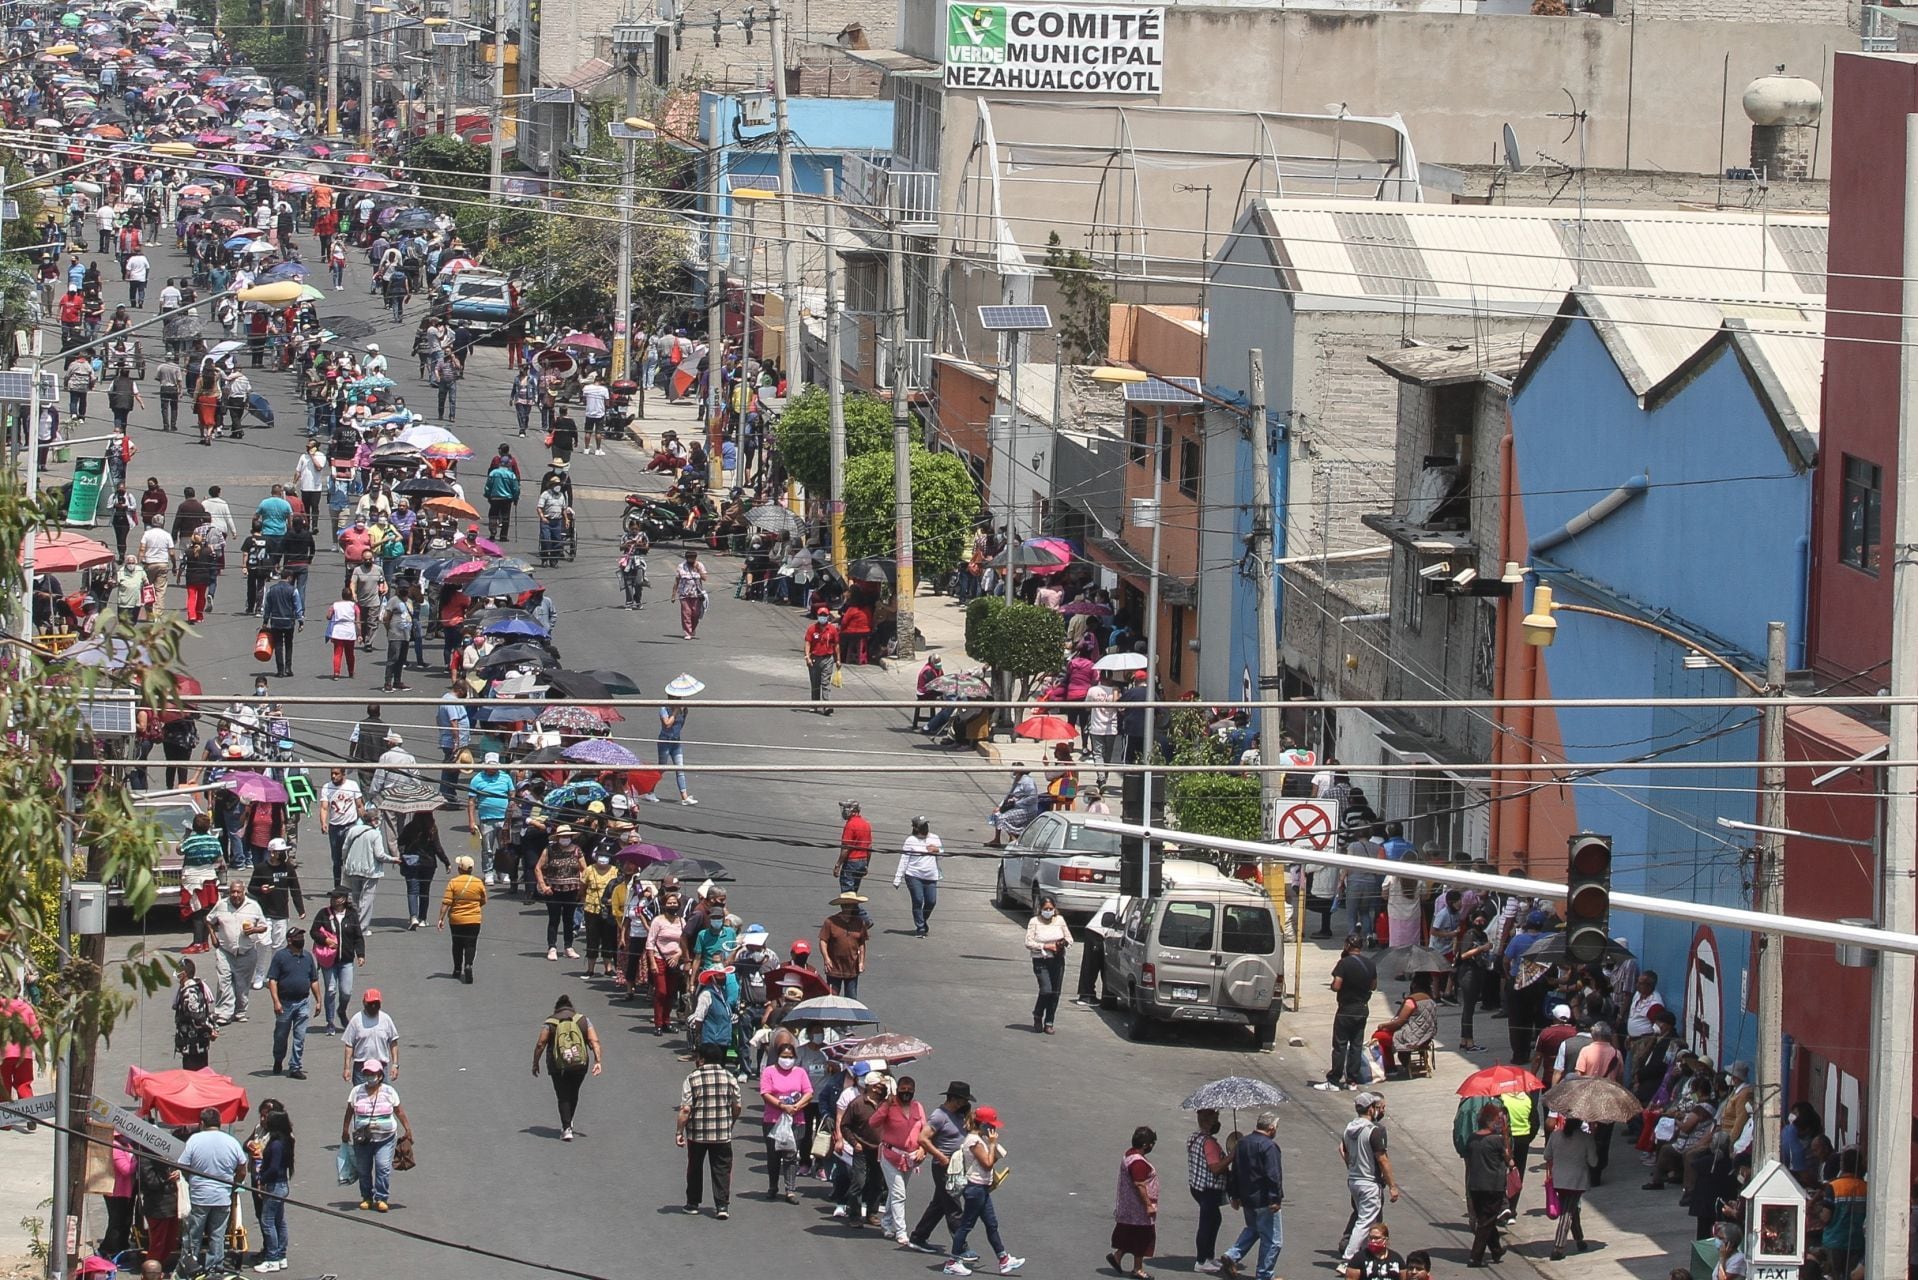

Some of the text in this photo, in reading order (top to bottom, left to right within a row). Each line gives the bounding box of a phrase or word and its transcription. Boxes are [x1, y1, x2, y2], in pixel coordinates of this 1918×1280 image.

[1011, 9, 1159, 40] COMITÉ
[949, 45, 1004, 63] VERDE
[1007, 43, 1162, 65] MUNICIPAL
[946, 66, 1160, 91] NEZAHUALCÓYOTL
[111, 1114, 172, 1154] PALOMA NEGRA
[1757, 1268, 1788, 1280] TAXI
